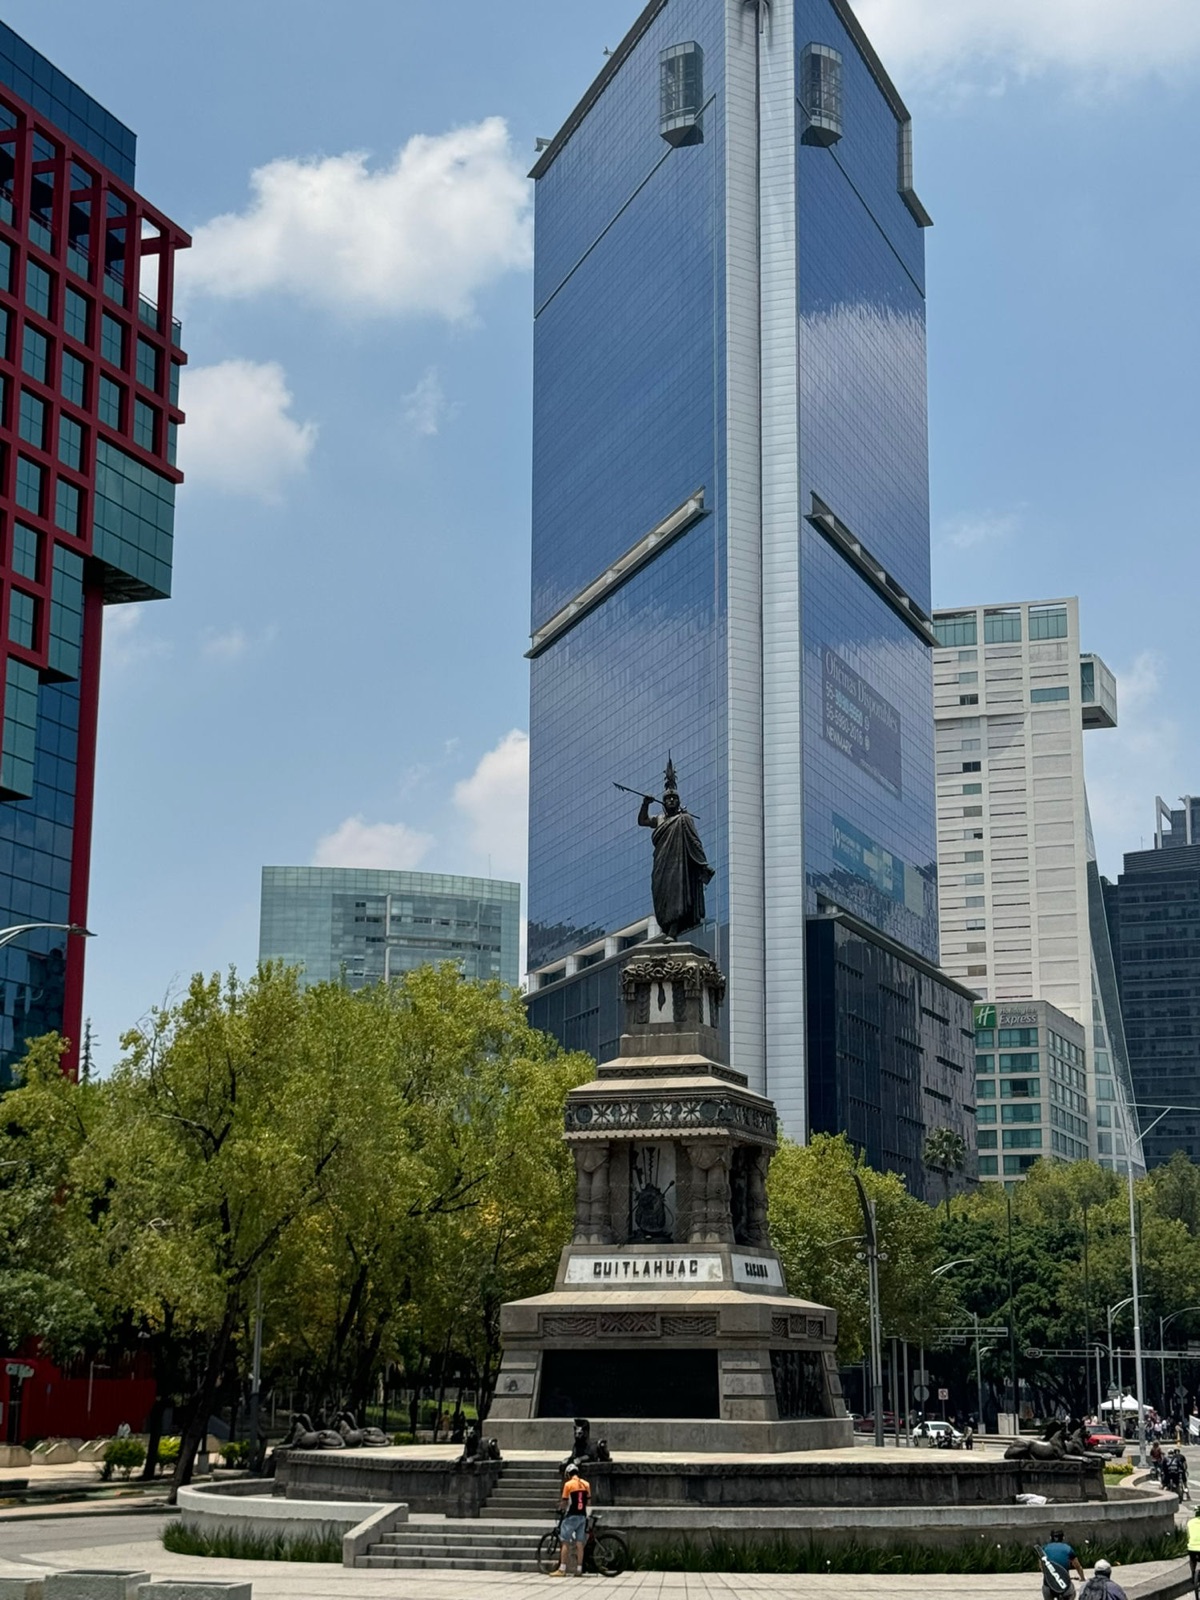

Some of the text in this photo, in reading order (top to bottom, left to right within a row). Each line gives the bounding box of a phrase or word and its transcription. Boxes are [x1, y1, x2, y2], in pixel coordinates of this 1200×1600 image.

[825, 651, 898, 734] Oficinas Disponibles
[1000, 1013, 1037, 1026] Express
[1041, 1556, 1068, 1590] HEAD
